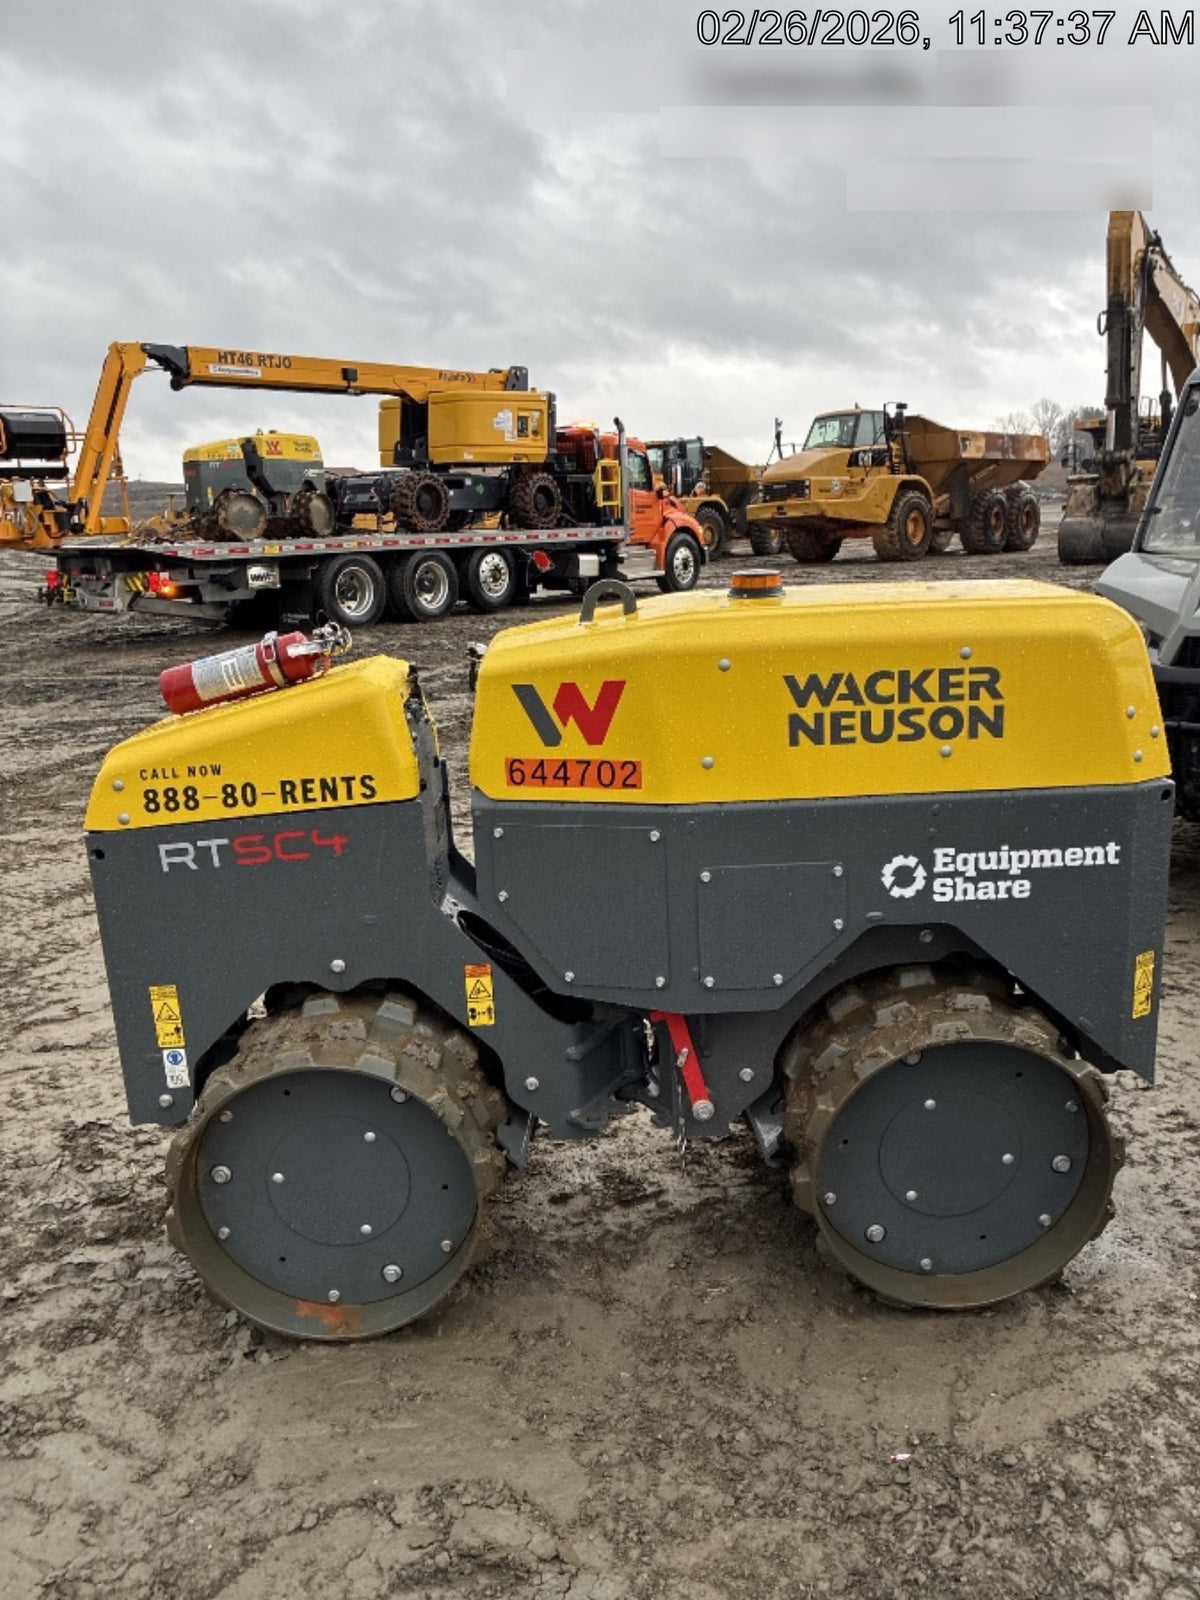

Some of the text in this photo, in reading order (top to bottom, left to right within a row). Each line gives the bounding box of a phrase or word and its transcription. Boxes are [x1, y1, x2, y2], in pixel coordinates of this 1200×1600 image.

[218, 351, 253, 367] HT46
[782, 666, 1005, 708] WACKER
[788, 704, 1005, 747] NEUSON
[139, 764, 222, 781] CALL NOW
[508, 758, 638, 788] 644702
[142, 774, 377, 814] 888-80-RENTS
[158, 829, 348, 872] RTSC4
[933, 841, 1121, 876] Equipment
[933, 878, 1031, 902] Share
